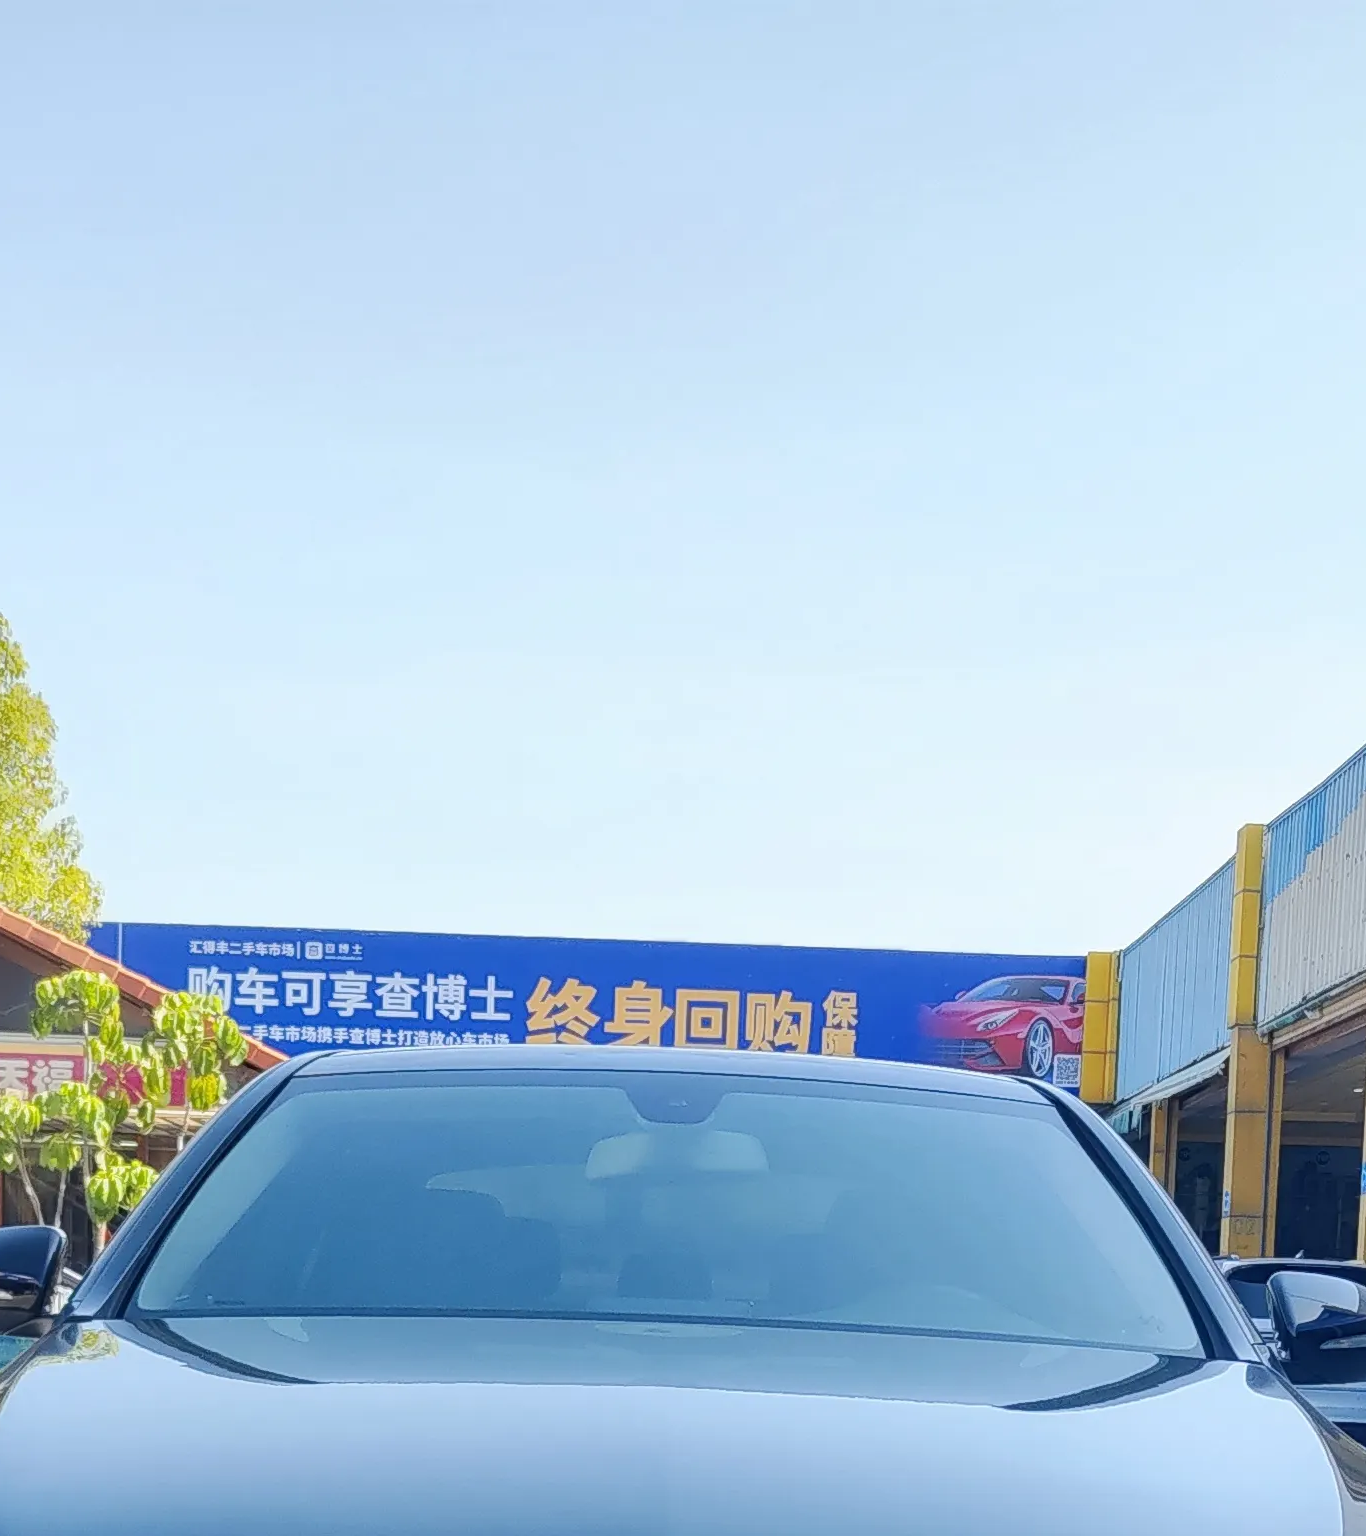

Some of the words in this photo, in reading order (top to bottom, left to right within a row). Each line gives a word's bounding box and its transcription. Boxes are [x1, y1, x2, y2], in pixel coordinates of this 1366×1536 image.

[189, 940, 295, 957] 汇得丰二手车市场
[187, 964, 514, 1021] 购车可享查博士
